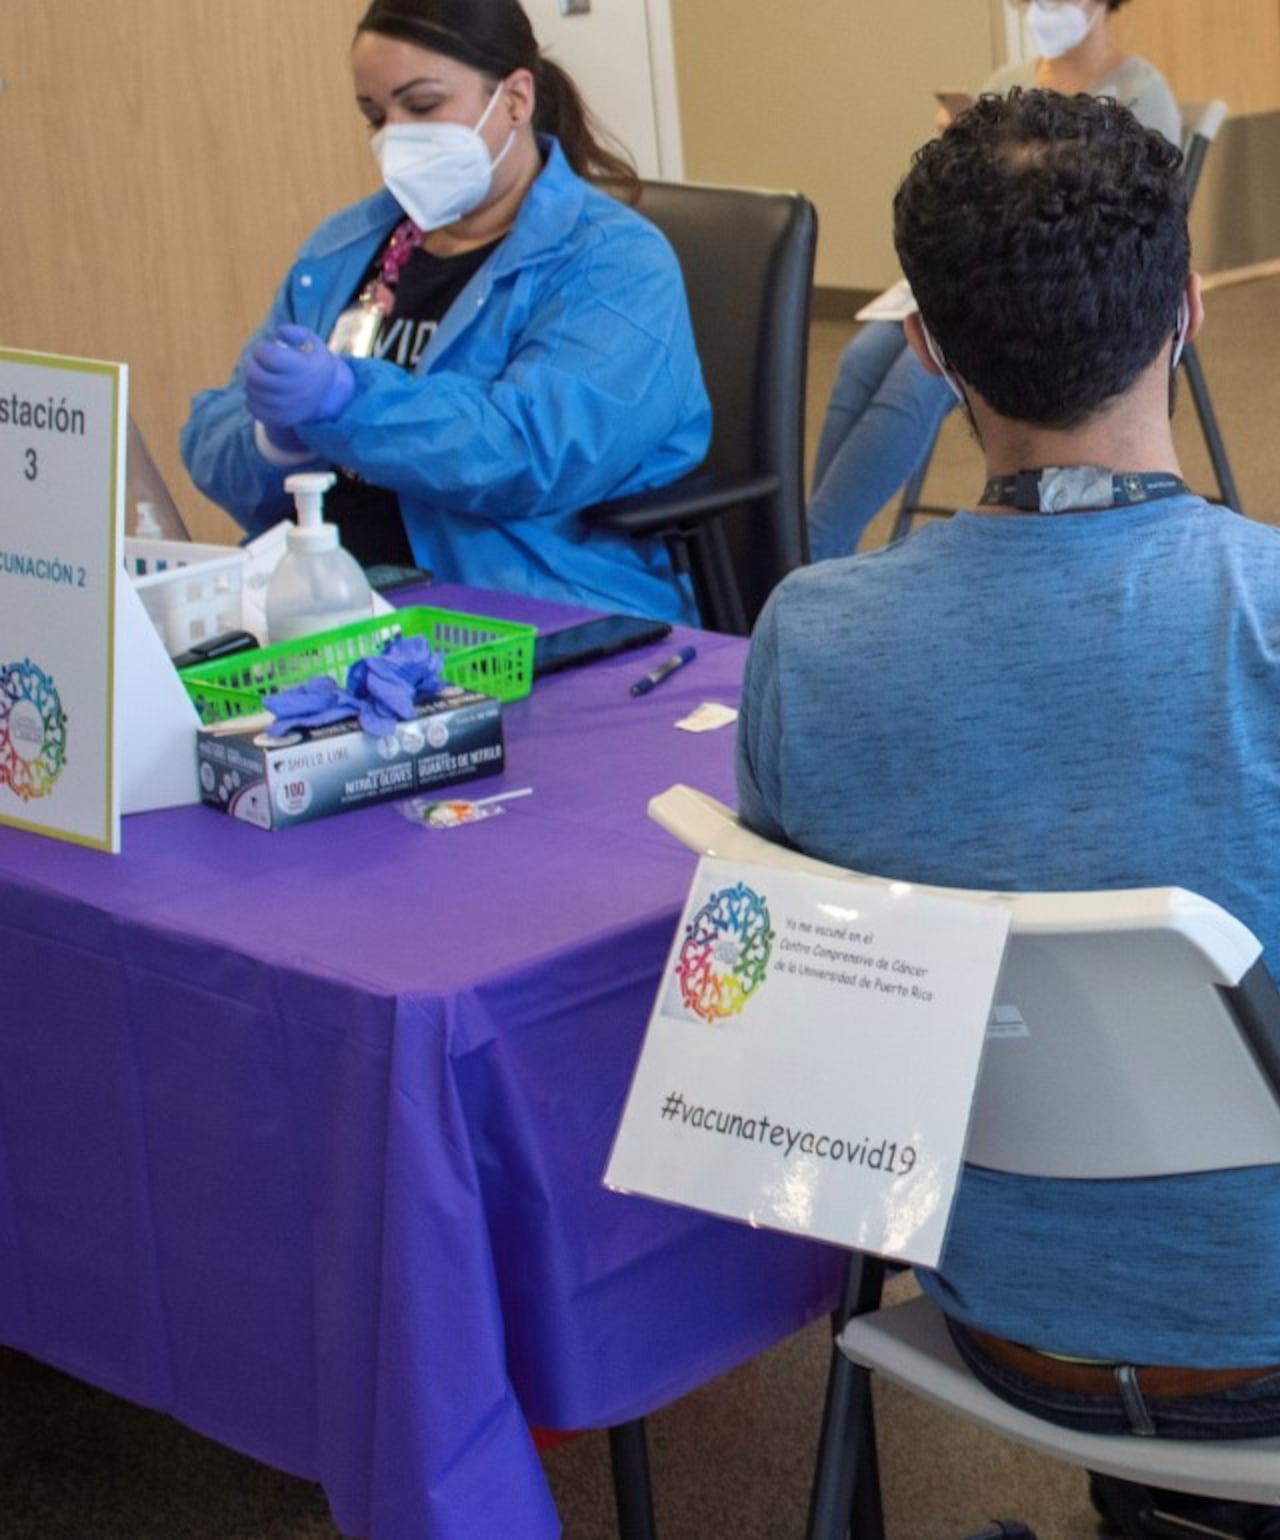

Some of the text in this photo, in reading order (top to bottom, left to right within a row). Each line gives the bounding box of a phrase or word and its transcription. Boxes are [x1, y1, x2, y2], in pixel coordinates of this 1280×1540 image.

[24, 447, 38, 482] 3
[77, 566, 87, 588] 2
[284, 780, 305, 799] 100
[786, 917, 874, 944] Ya me vacuné en el
[779, 937, 929, 977] Centro Comprensivo de Cáncer
[774, 960, 934, 1002] de la Universidad de Puerto Rico
[660, 1091, 917, 1177] #vacunateyacovid19
